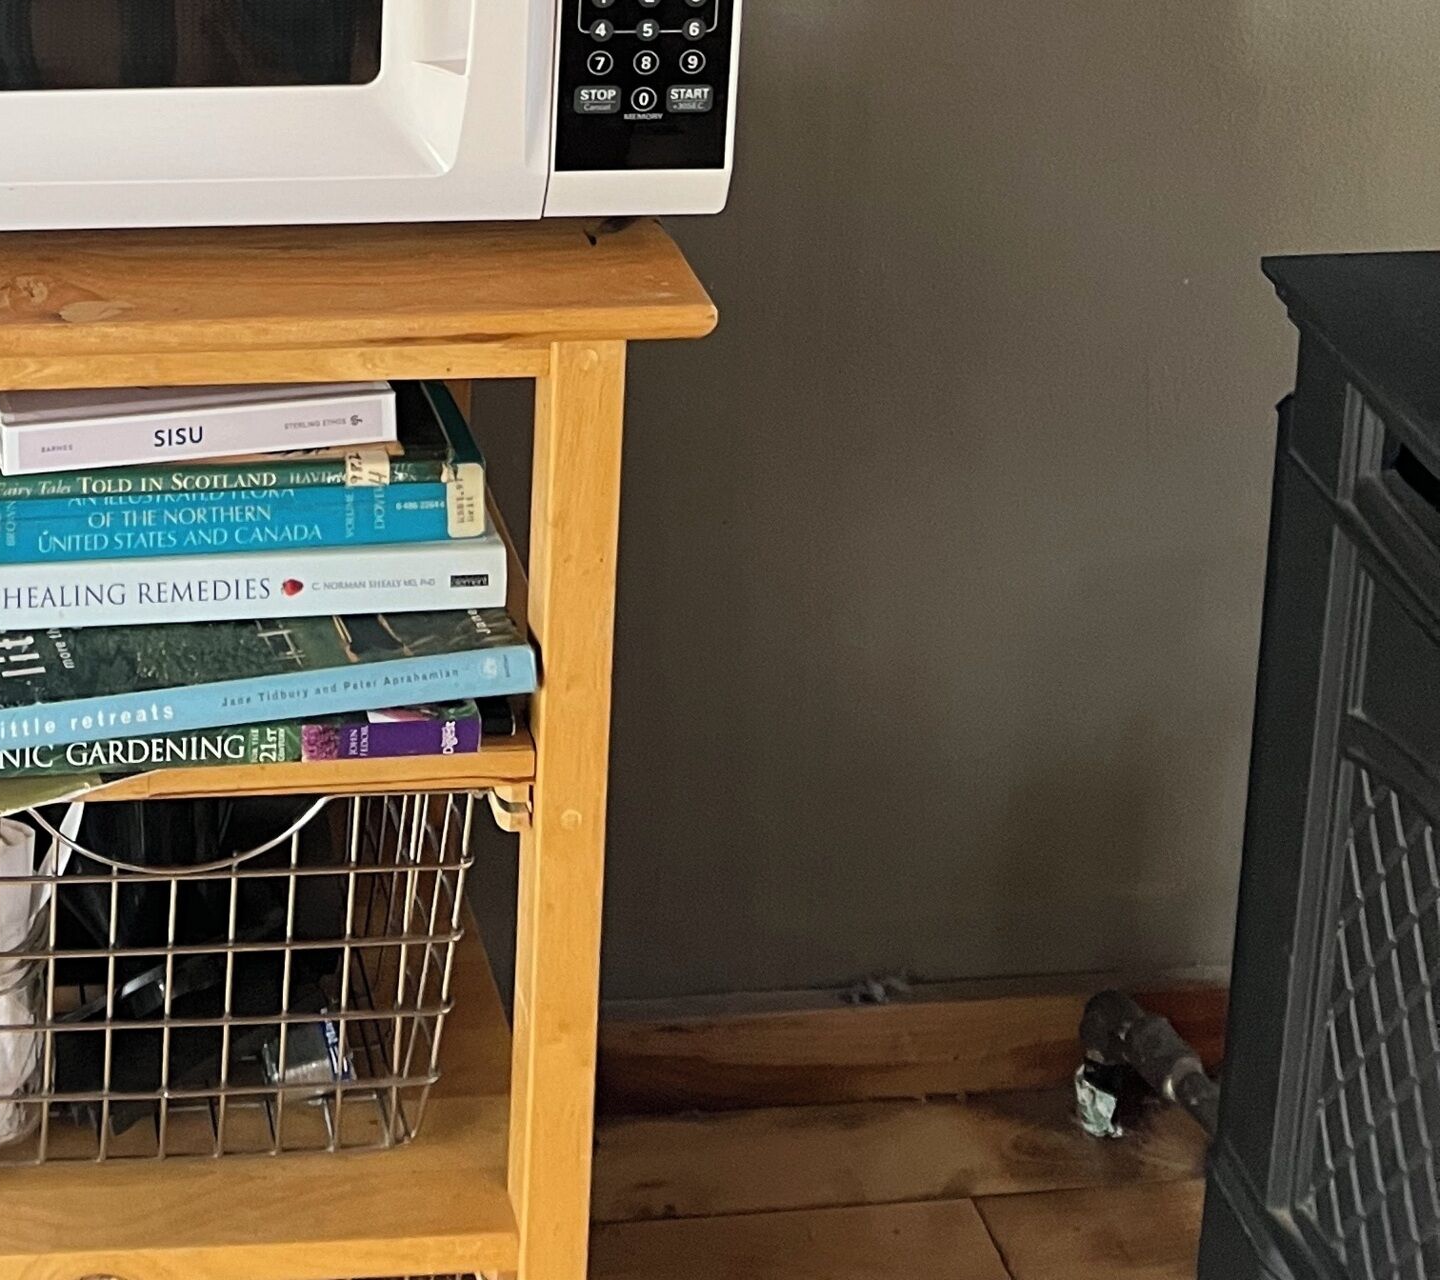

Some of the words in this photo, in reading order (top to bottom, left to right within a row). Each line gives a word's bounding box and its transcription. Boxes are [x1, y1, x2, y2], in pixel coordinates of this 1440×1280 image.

[595, 22, 606, 37] 4
[642, 23, 653, 37] 5
[689, 22, 700, 36] 6
[594, 56, 606, 70] 7
[641, 56, 652, 70] 8
[687, 55, 698, 69] 9
[580, 89, 617, 101] STOP
[639, 92, 649, 106] 0
[670, 88, 710, 100] START
[284, 420, 320, 430] STERLING
[322, 418, 346, 427] ETHOS
[154, 426, 203, 448] SISU
[37, 479, 72, 495] Tales
[141, 476, 162, 493] IN
[88, 511, 111, 529] OF
[121, 510, 158, 527] THE
[162, 505, 272, 526] NORTHERN
[344, 492, 355, 538] VOLUME
[38, 536, 108, 554] UNITED
[113, 531, 177, 550] STATES
[183, 528, 228, 546] AND
[234, 524, 323, 544] CANADA
[3, 583, 127, 610] HEALING
[138, 578, 272, 605] REMEDIES
[323, 580, 366, 590] NORMAN
[369, 579, 401, 589] SHEALY
[55, 641, 76, 671] more
[222, 696, 252, 707] Jane
[258, 689, 309, 702] Tidbury
[315, 683, 338, 695] and
[343, 680, 378, 691] Peter
[70, 703, 175, 731] retreats
[66, 734, 246, 767] GARDENING
[259, 728, 278, 762] 21ST
[348, 728, 358, 756] JOHN
